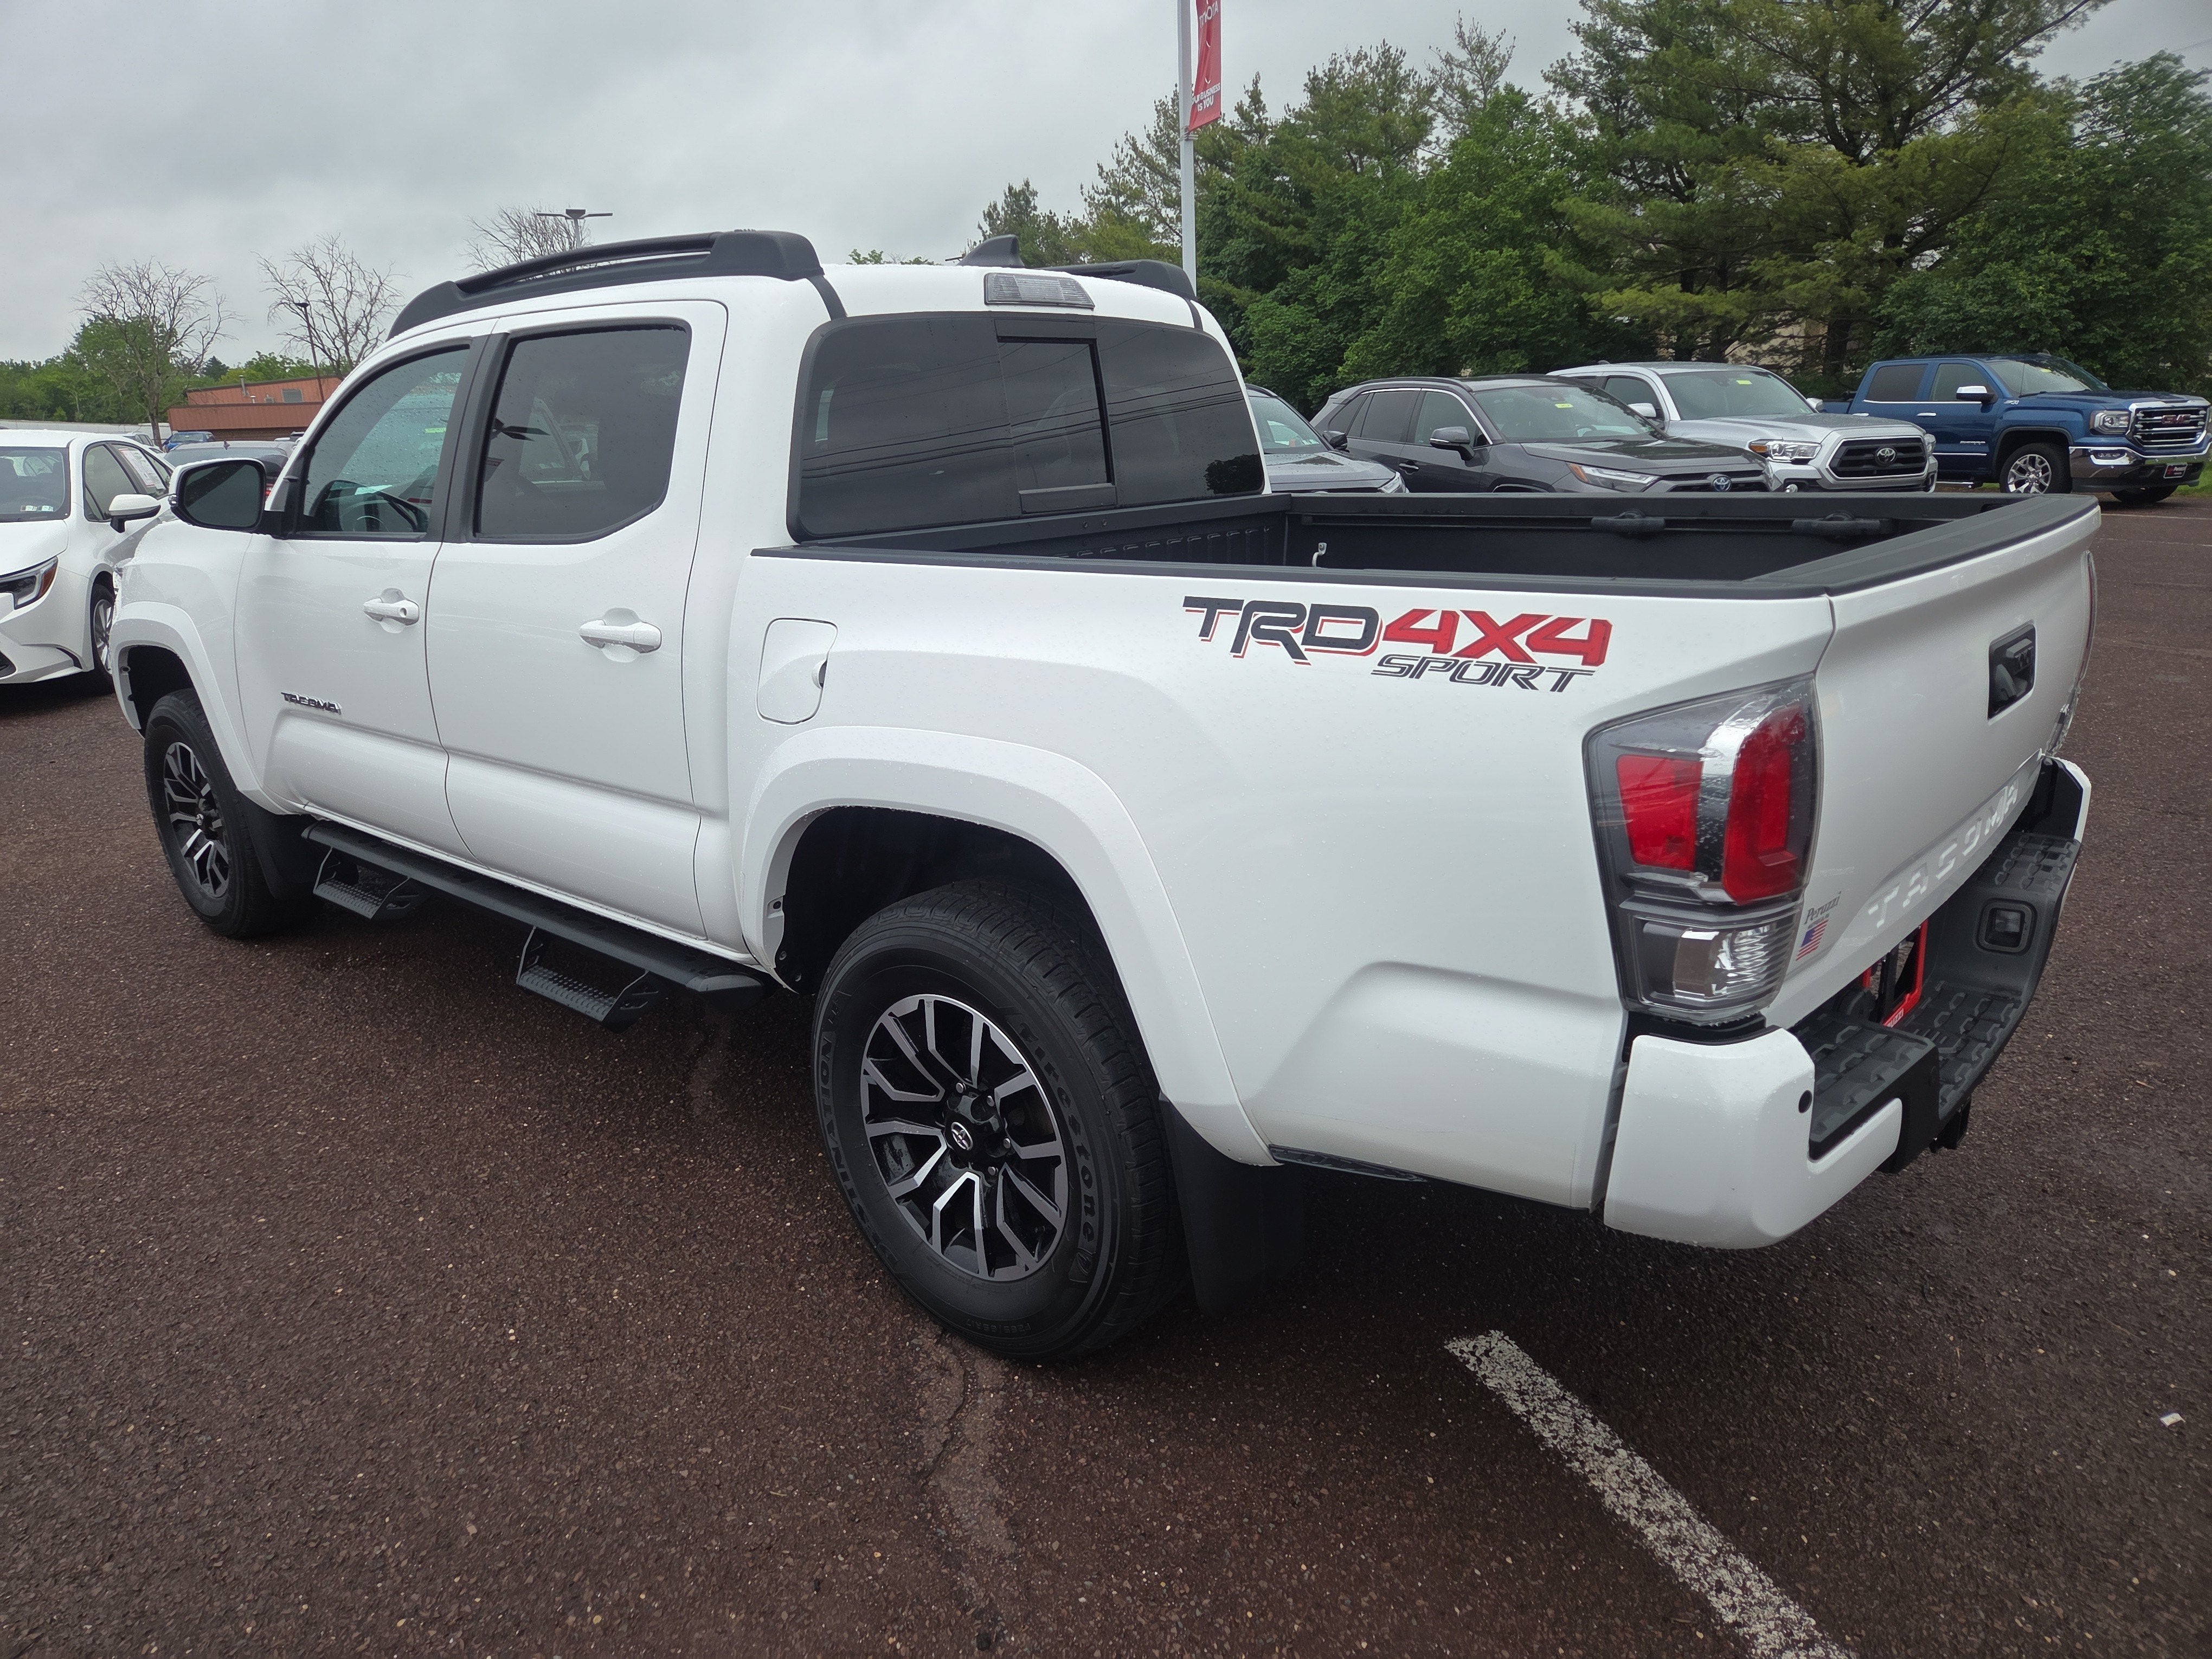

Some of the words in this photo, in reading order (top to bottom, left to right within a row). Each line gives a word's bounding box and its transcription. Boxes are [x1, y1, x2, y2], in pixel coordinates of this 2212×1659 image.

[1183, 595, 1384, 665] TRD
[1382, 608, 1612, 667] 4X4
[1371, 654, 1596, 692] SPORT
[280, 690, 343, 715] TACOMA
[1868, 778, 2019, 928] TACOMA
[1804, 891, 1842, 925] Peruzzi
[1021, 1022, 1095, 1243] Firestone
